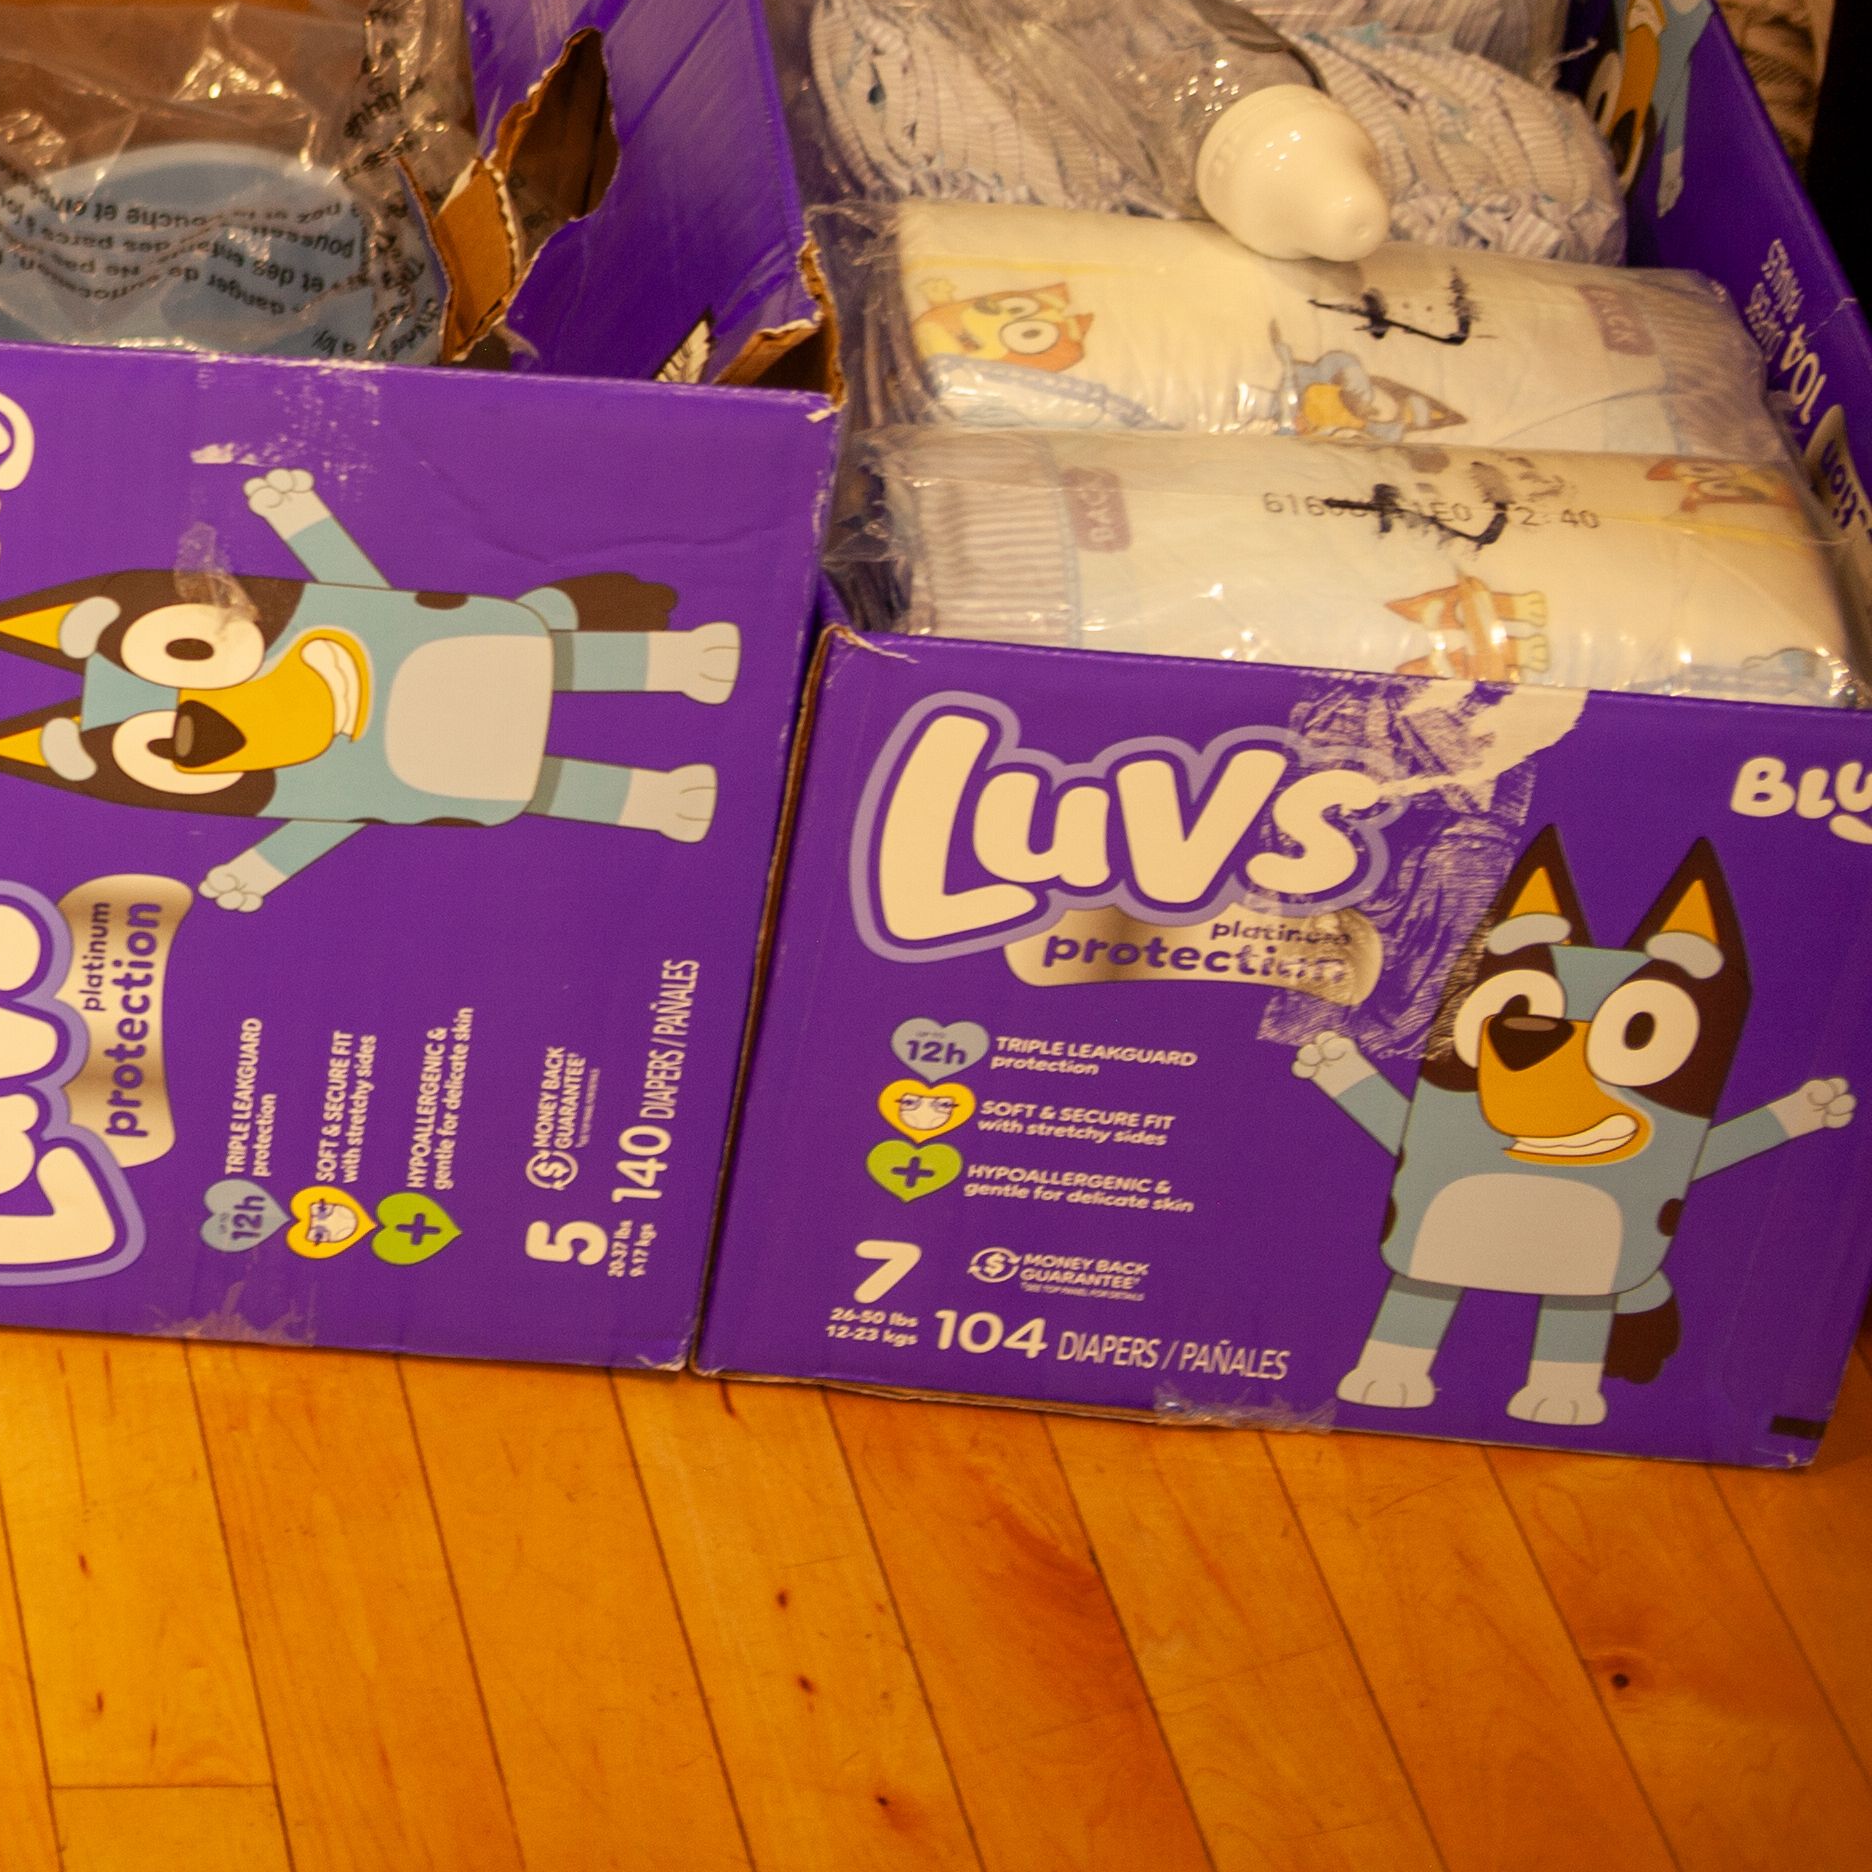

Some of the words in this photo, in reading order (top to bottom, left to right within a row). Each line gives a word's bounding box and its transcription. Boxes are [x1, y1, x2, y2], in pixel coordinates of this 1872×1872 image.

[82, 900, 113, 1013] platinum
[1042, 929, 1350, 985] protection
[650, 958, 701, 1035] PAÑALES
[104, 900, 164, 1141] protection
[332, 1029, 355, 1055] FIT
[453, 1006, 475, 1041] skin
[231, 1017, 264, 1121] LEAKGUARD
[354, 1033, 378, 1077] sides
[542, 1046, 567, 1090] BACK
[907, 1039, 968, 1067] 12h
[990, 1055, 1100, 1076] protection
[996, 1035, 1065, 1057] TRIPLE
[1067, 1041, 1199, 1068] LEAKGUARD
[323, 1058, 351, 1122] SECURE
[442, 1044, 471, 1110] delicate
[639, 1048, 688, 1119] DIAPERS
[344, 1078, 376, 1146] stretchy
[407, 1042, 446, 1188] HYPOALLERGENIC
[439, 1112, 461, 1135] for
[532, 1091, 564, 1148] MONEY
[978, 1117, 1023, 1134] with
[1025, 1122, 1110, 1145] stretchy
[1113, 1128, 1168, 1147] sides
[980, 1100, 1038, 1119] SOFT
[1059, 1107, 1141, 1130] SECURE
[1143, 1114, 1176, 1130] FIT
[225, 1122, 253, 1175] TRIPLE
[252, 1092, 277, 1177] protection
[316, 1138, 339, 1182] SOFT
[342, 1147, 360, 1183] with
[434, 1139, 457, 1190] gentle
[610, 1125, 673, 1204] 140
[967, 1164, 1153, 1193] HYPOALLERGENIC
[231, 1194, 268, 1241] 12h
[964, 1181, 1030, 1201] gentle
[1032, 1185, 1064, 1202] for
[1066, 1189, 1150, 1212] delicate
[1151, 1196, 1195, 1214] skin
[524, 1219, 609, 1266] 5
[613, 1219, 634, 1239] lbs
[633, 1222, 658, 1247] kgs
[607, 1240, 630, 1278] 20-37
[629, 1248, 649, 1277] 9-17
[853, 1239, 923, 1305] 7
[1022, 1251, 1094, 1272] MONEY
[1095, 1258, 1152, 1277] BACK
[825, 1323, 881, 1343] 12-23
[882, 1328, 919, 1348] kgs
[829, 1307, 886, 1325] 26-50
[888, 1310, 919, 1329] lbs
[935, 1308, 1049, 1359] 104
[1056, 1329, 1160, 1369] DIAPERS
[1179, 1338, 1292, 1382] PAÑALES
